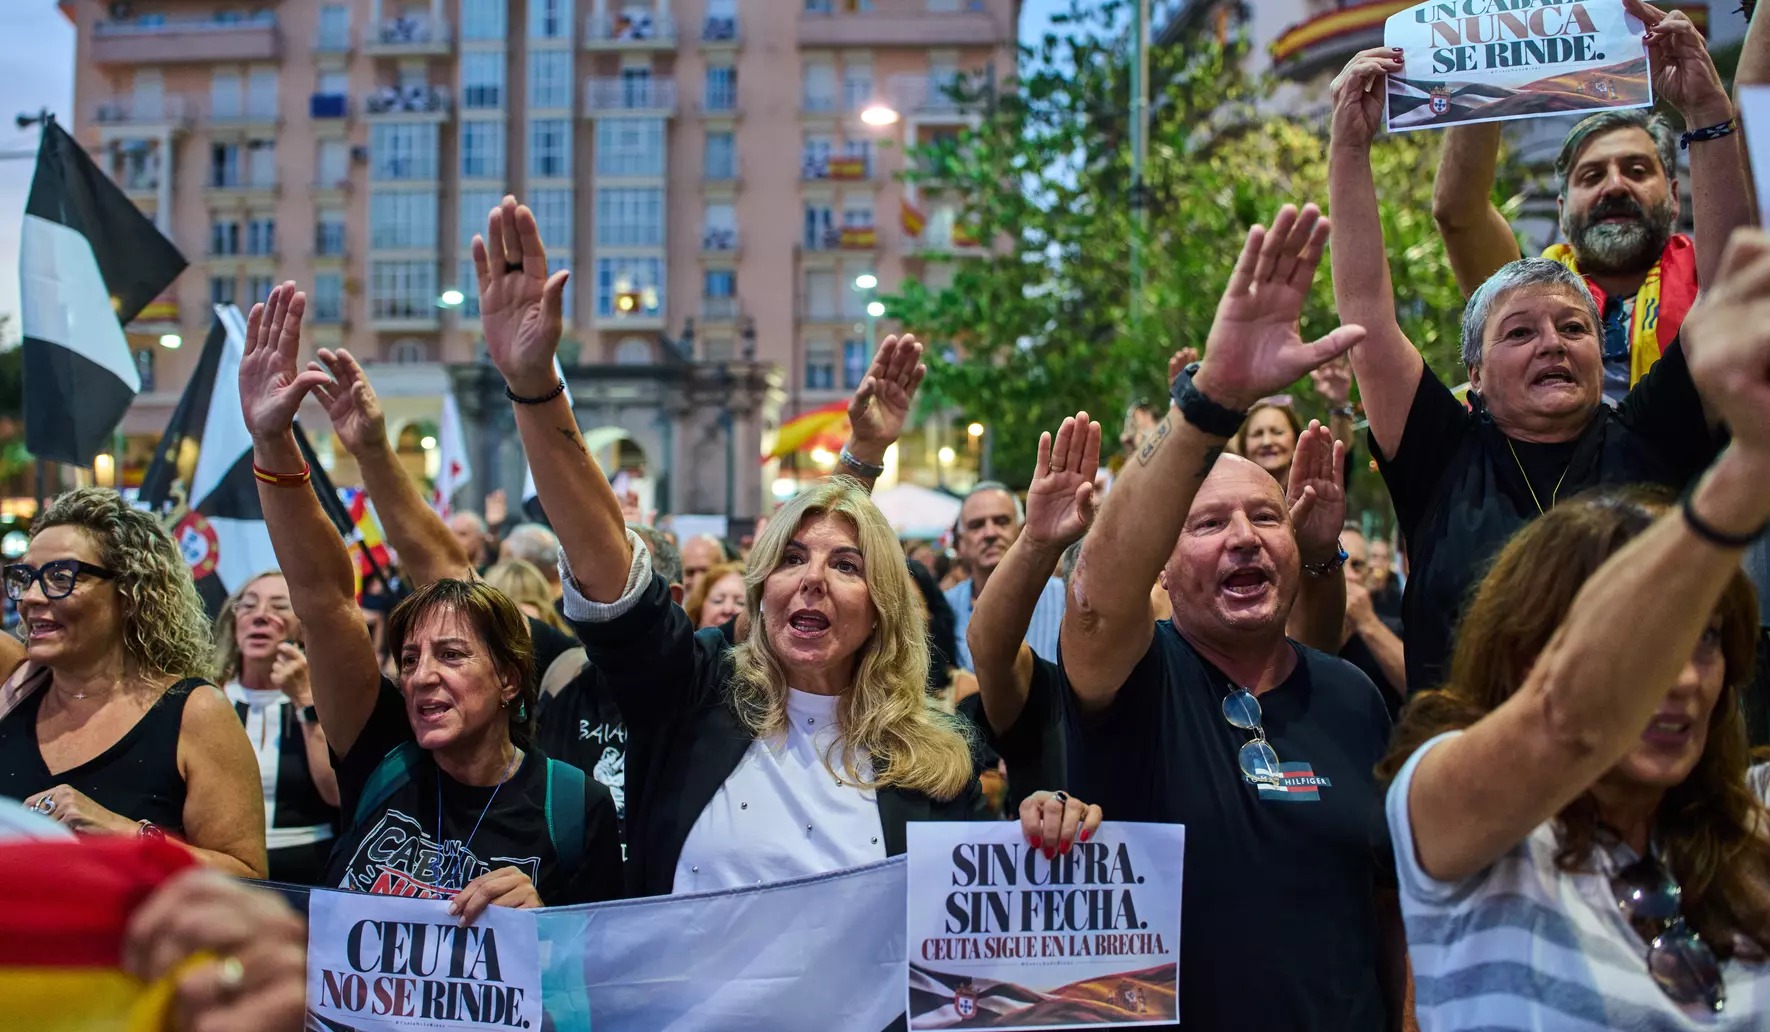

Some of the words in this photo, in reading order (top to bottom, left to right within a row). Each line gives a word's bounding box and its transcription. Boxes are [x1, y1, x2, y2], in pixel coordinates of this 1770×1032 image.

[1415, 0, 1456, 24] UN
[1428, 4, 1600, 49] NUNCA
[1432, 45, 1478, 75] SE
[1485, 34, 1606, 70] RINDE.
[1285, 777, 1327, 786] HILFIGER
[443, 840, 462, 856] UN
[951, 843, 1020, 887] SIN
[1024, 842, 1145, 886] CIFRA.
[945, 891, 1012, 934] SIN
[1020, 888, 1148, 933] FECHA.
[346, 919, 504, 983] CEUTA
[921, 937, 981, 961] CEUTA
[983, 936, 1037, 960] SIGUE
[1041, 935, 1065, 957] EN
[1069, 935, 1092, 956] LA
[1095, 933, 1169, 956] BRECHA.
[319, 968, 368, 1012] NO
[371, 976, 417, 1017] SE
[420, 979, 530, 1029] RINDE.
